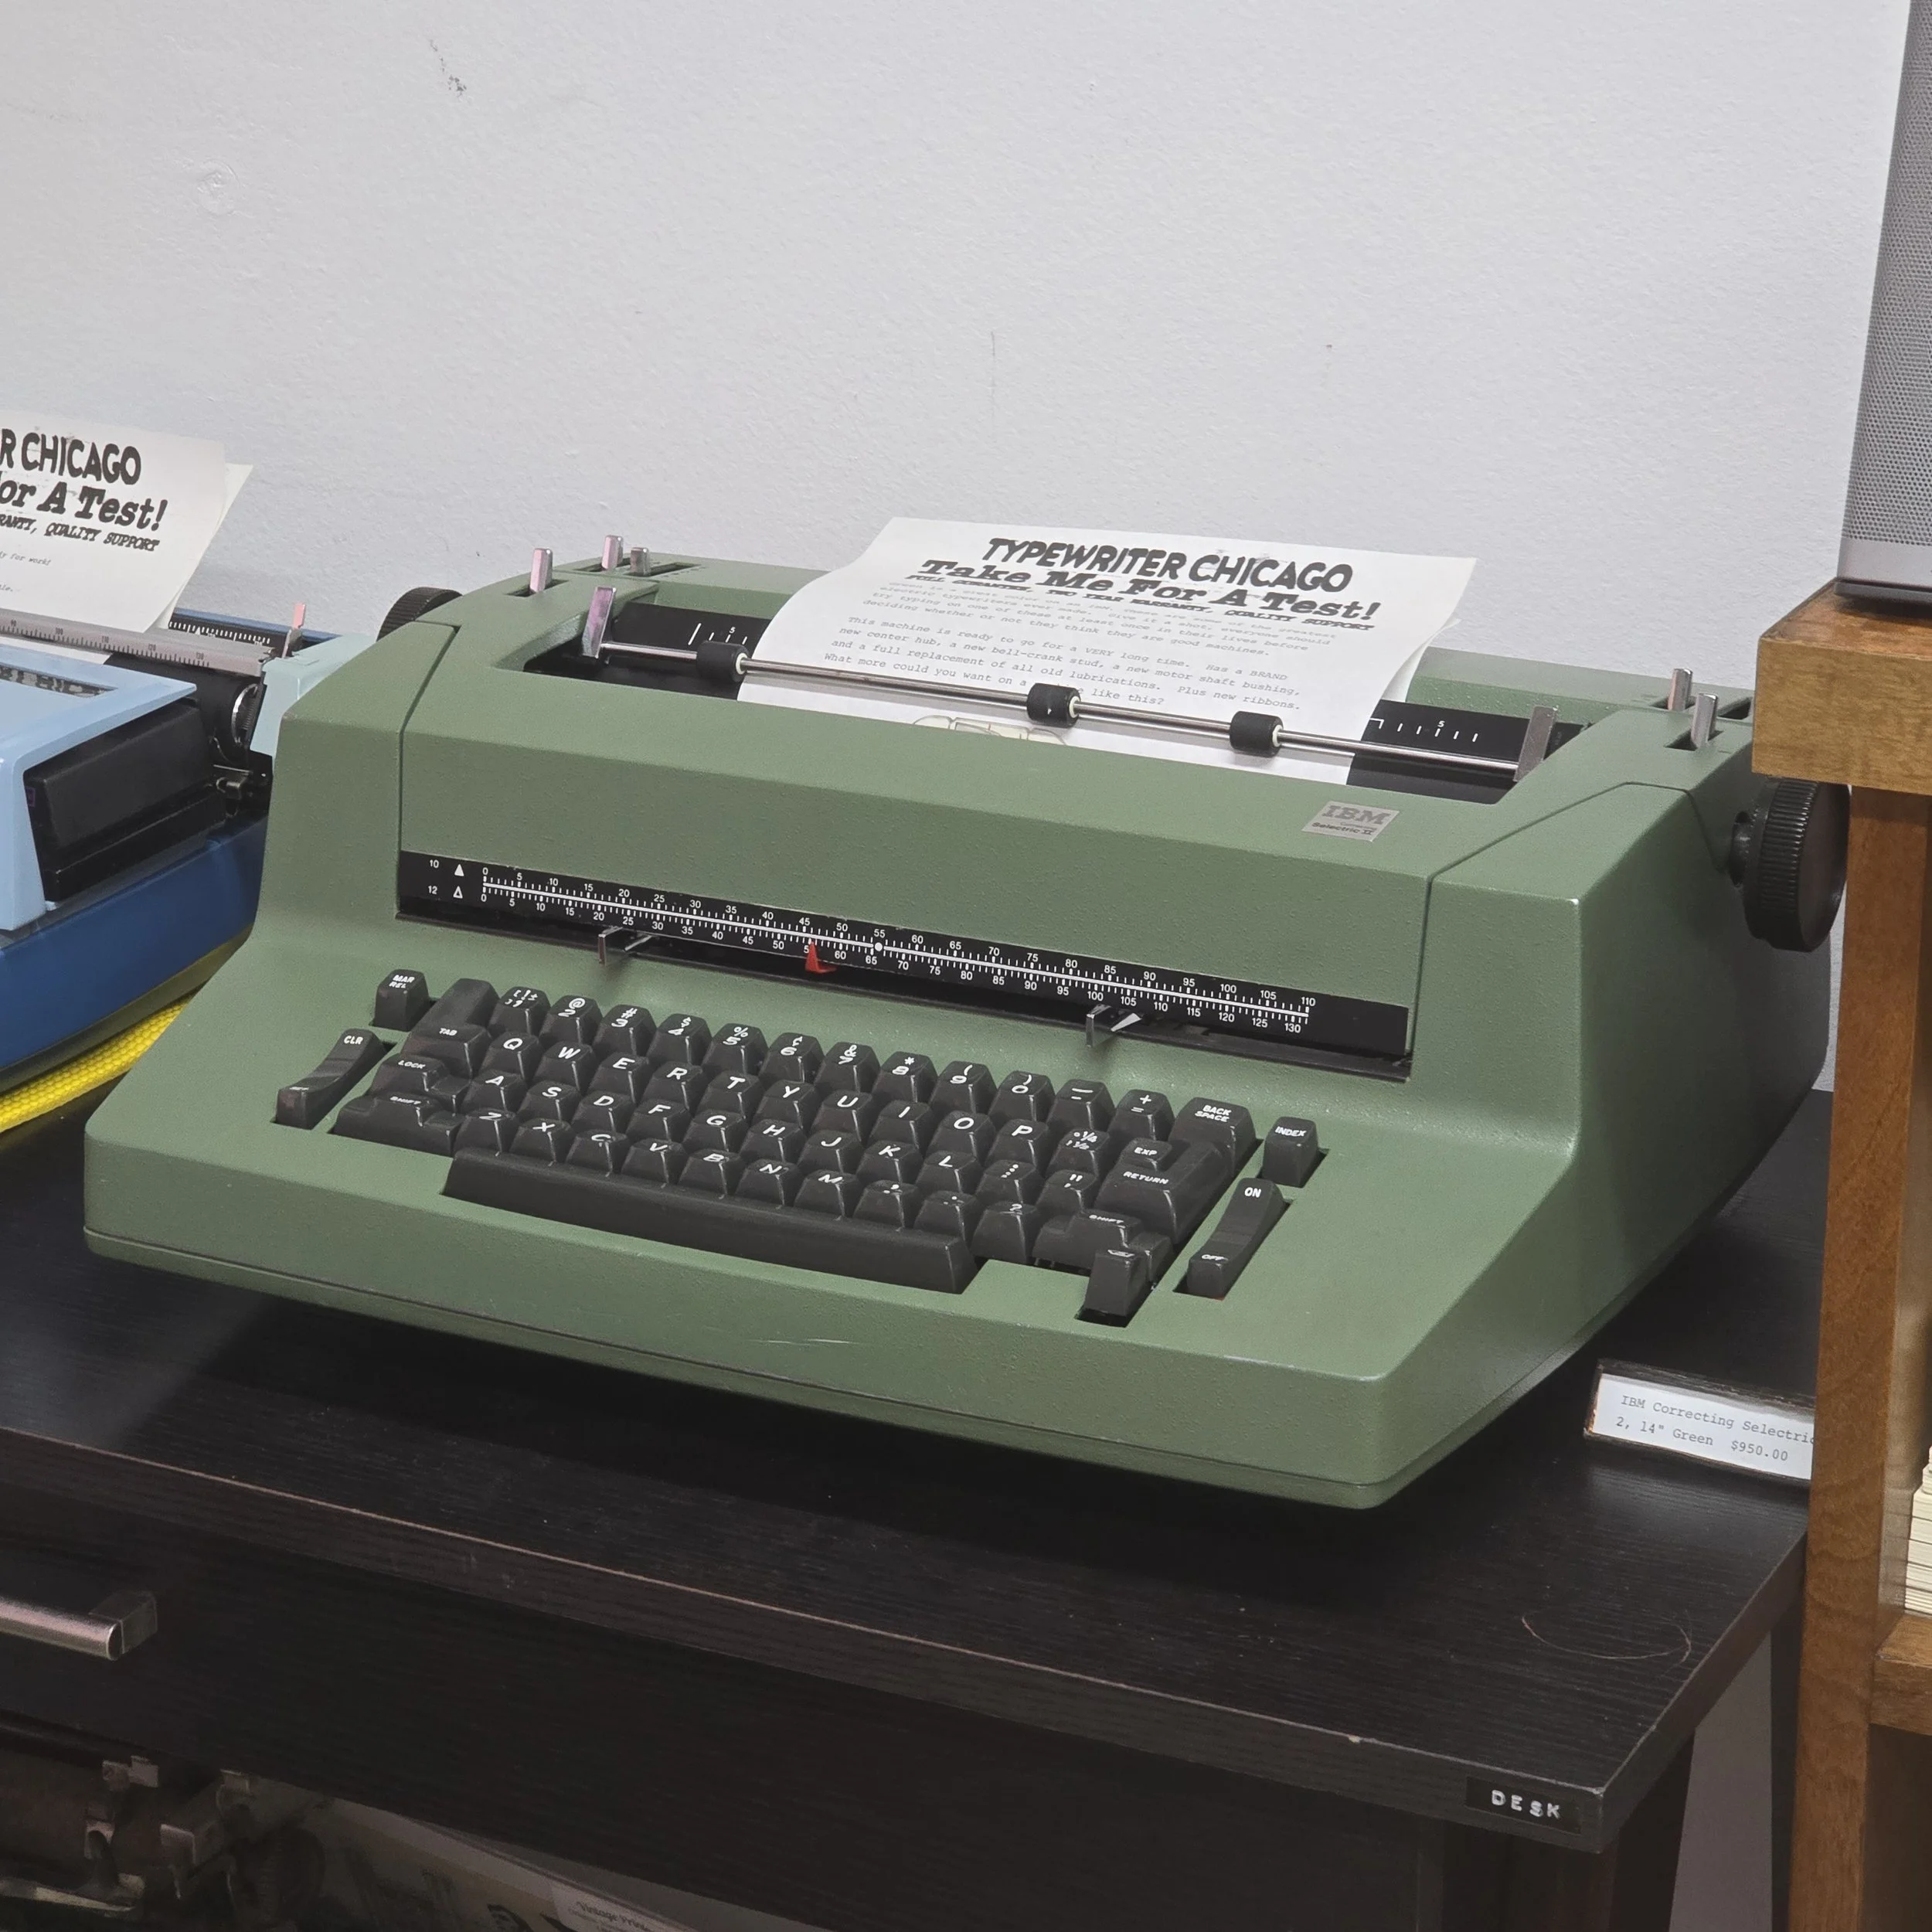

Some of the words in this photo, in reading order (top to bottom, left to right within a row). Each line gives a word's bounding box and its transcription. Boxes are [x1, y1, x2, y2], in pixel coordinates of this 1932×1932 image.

[22, 432, 141, 485] CHICAGO
[0, 471, 36, 508] or
[36, 481, 67, 515] A
[74, 485, 168, 531] Test!
[44, 522, 102, 542] QUALITY
[103, 532, 160, 552] SUPPORT
[981, 538, 1187, 580] TYPEWRITER
[1189, 554, 1353, 593] CHICAGO
[917, 560, 1031, 583] Take
[1035, 571, 1114, 591] Me
[1117, 579, 1207, 600] For
[1208, 588, 1248, 607] A
[1259, 591, 1381, 621] Test!
[849, 617, 875, 625] This
[881, 621, 930, 632] machine
[957, 631, 993, 641] ready
[1085, 648, 1114, 657] VERY
[1121, 652, 1149, 663] long
[1157, 658, 1189, 668] time.
[1206, 665, 1229, 673] Has
[1249, 670, 1288, 681] BRAND
[1170, 638, 1200, 647] good
[1206, 642, 1269, 656] machines.
[866, 631, 910, 642] center
[914, 637, 942, 647] hub,
[992, 646, 1063, 662] bell-crank
[1069, 658, 1104, 668] stud,
[1126, 665, 1150, 674] new
[1155, 669, 1193, 681] motor
[1199, 675, 1236, 686] shaft
[1242, 681, 1301, 696] bushing,
[824, 653, 852, 663] What
[858, 658, 886, 668] more
[893, 663, 929, 674] could
[934, 668, 956, 678] you
[963, 672, 992, 682] want
[1091, 688, 1121, 699] like
[1128, 694, 1165, 705] this?
[831, 640, 853, 648] and
[873, 644, 901, 655] full
[906, 650, 985, 666] replacement
[991, 660, 1006, 668] of
[1012, 663, 1033, 672] all
[1040, 668, 1063, 677] old
[1069, 671, 1161, 690] lubrications.
[1177, 685, 1206, 696] Plus
[1213, 692, 1236, 700] new
[1243, 696, 1300, 710] ribbons.
[1321, 804, 1391, 825] IBM
[1311, 822, 1360, 834] Selectric
[429, 859, 440, 869] 10
[427, 886, 438, 895] 12
[482, 866, 488, 876] 0
[516, 872, 523, 881] 5
[549, 878, 559, 886] 10
[583, 883, 594, 892] 15
[618, 889, 630, 898] 20
[654, 893, 665, 903] 25
[689, 900, 702, 909] 30
[725, 905, 737, 914] 35
[761, 911, 774, 920] 40
[798, 917, 811, 926] 45
[836, 923, 849, 932] 50
[873, 929, 886, 938] 55
[911, 934, 923, 944] 60
[949, 940, 961, 950] 65
[988, 947, 1000, 957] 70
[1026, 952, 1039, 962] 75
[1065, 958, 1078, 968] 80
[1104, 964, 1116, 975] 85
[1143, 971, 1156, 981] 90
[1182, 977, 1196, 987] 95
[1220, 983, 1237, 994] 100
[1260, 989, 1277, 1000] 105
[1301, 995, 1316, 1007] 110
[393, 974, 415, 984] MAR
[439, 1028, 457, 1036] TAB
[343, 1036, 363, 1045] CLR
[503, 1038, 523, 1050] Q
[558, 1046, 581, 1059] W
[398, 1060, 425, 1070] LOCK
[612, 1056, 635, 1070] E
[666, 1066, 688, 1080] R
[485, 1075, 505, 1086] A
[726, 1076, 746, 1090] T
[542, 1087, 562, 1098] S
[782, 1085, 801, 1098] Y
[389, 1096, 421, 1105] SHIFT
[593, 1095, 614, 1107] D
[837, 1095, 859, 1107] U
[648, 1104, 672, 1114] F
[898, 1106, 910, 1118] I
[1202, 1104, 1232, 1116] BACK
[479, 1112, 502, 1121] Z
[706, 1114, 727, 1126] G
[1195, 1111, 1230, 1123] SPACE
[532, 1121, 556, 1132] X
[954, 1117, 975, 1129] O
[763, 1124, 786, 1136] H
[1012, 1124, 1033, 1136] P
[1274, 1126, 1307, 1138] INDEX
[590, 1134, 611, 1142] C
[821, 1137, 842, 1147] J
[649, 1142, 668, 1152] V
[878, 1145, 901, 1157] K
[1134, 1147, 1158, 1156] EXP
[702, 1153, 725, 1162] B
[938, 1155, 953, 1167] L
[759, 1163, 783, 1174] N
[818, 1174, 843, 1184] M
[1123, 1171, 1168, 1185] RETURN
[1244, 1186, 1262, 1198] ON
[1089, 1214, 1124, 1224] SHIFT
[1621, 1395, 1646, 1409] IBM
[1653, 1402, 1735, 1429] Correcting
[1616, 1416, 1630, 1430] 2,
[1640, 1421, 1665, 1434] 14"
[1672, 1428, 1714, 1446] Green
[1730, 1440, 1788, 1461] $950.00
[1492, 1789, 1560, 1818] DESK
